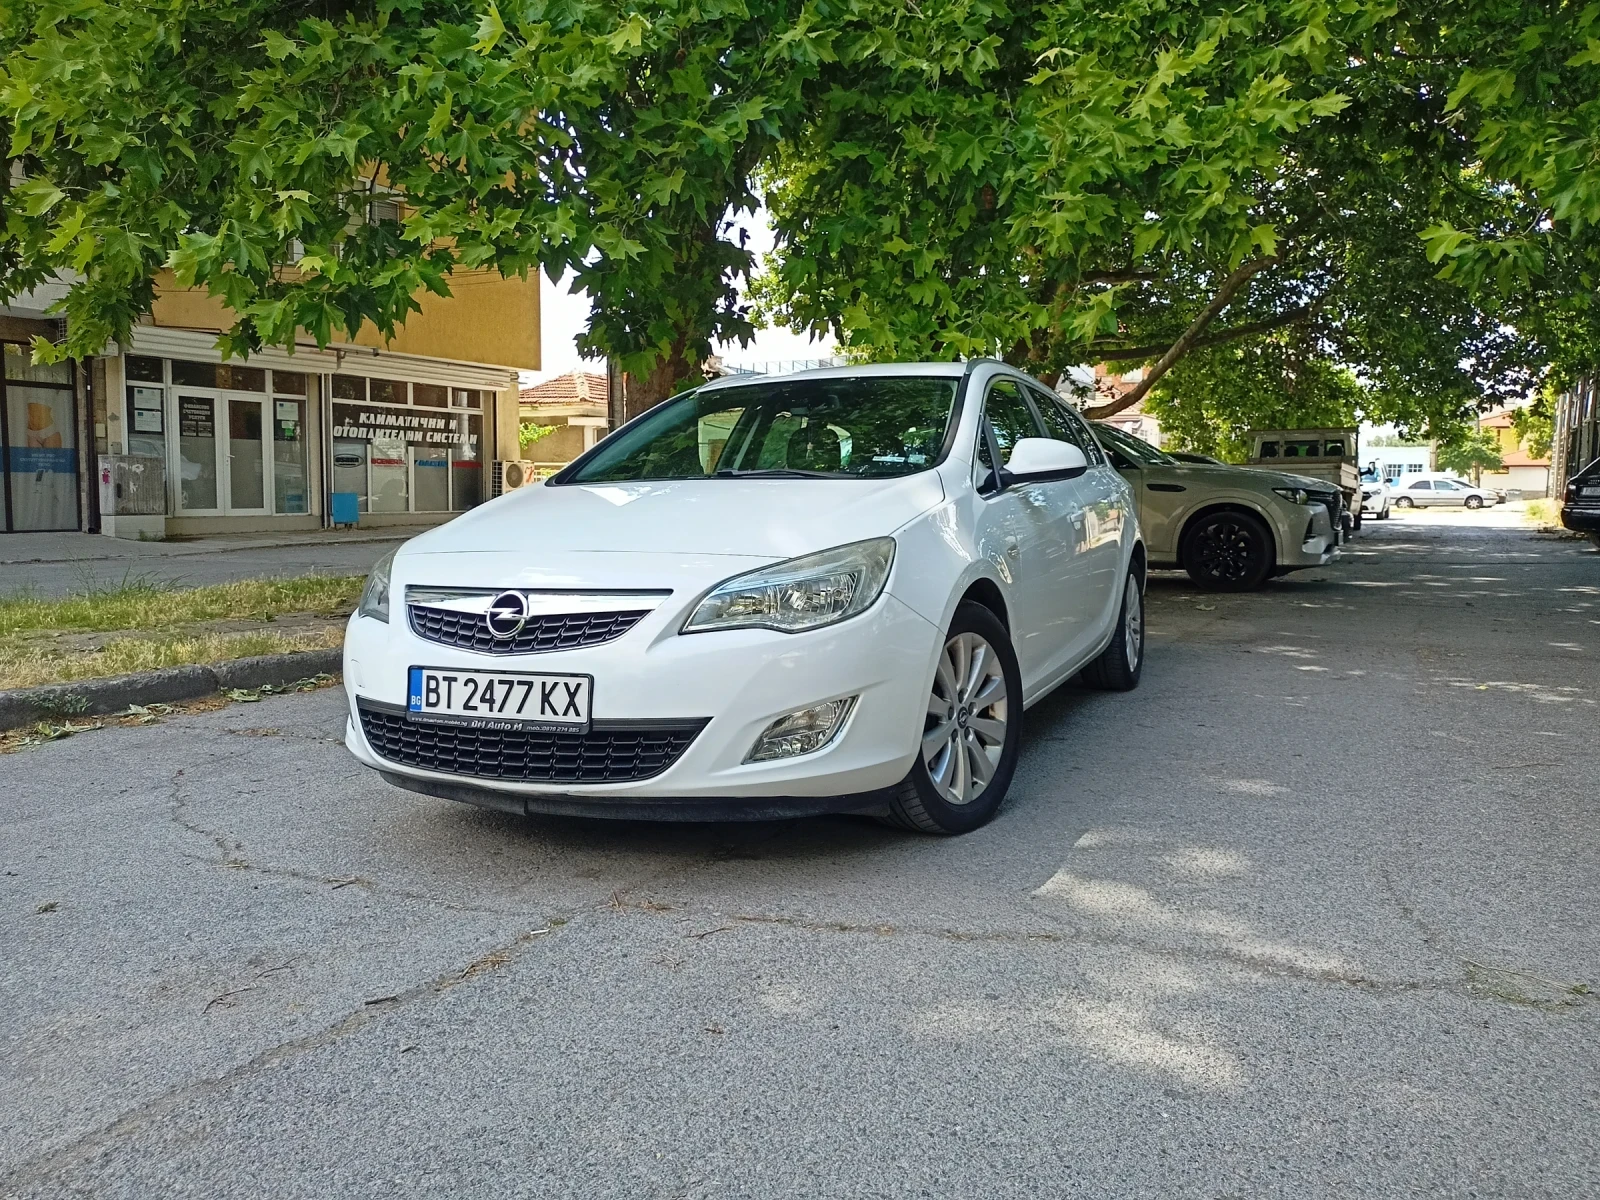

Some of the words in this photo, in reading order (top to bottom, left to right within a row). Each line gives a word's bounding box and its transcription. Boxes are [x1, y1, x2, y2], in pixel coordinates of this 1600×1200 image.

[359, 413, 445, 429] КЛИМАТИЧНИ
[449, 419, 457, 430] И
[333, 426, 423, 441] ОТОПЛИТЕЛНИ
[426, 432, 477, 444] СИСТЕМИ
[411, 695, 421, 706] BG
[425, 674, 458, 710] BT
[462, 677, 534, 714] 2477
[540, 681, 582, 718] KX
[487, 721, 511, 730] Auto
[513, 723, 523, 731] M
